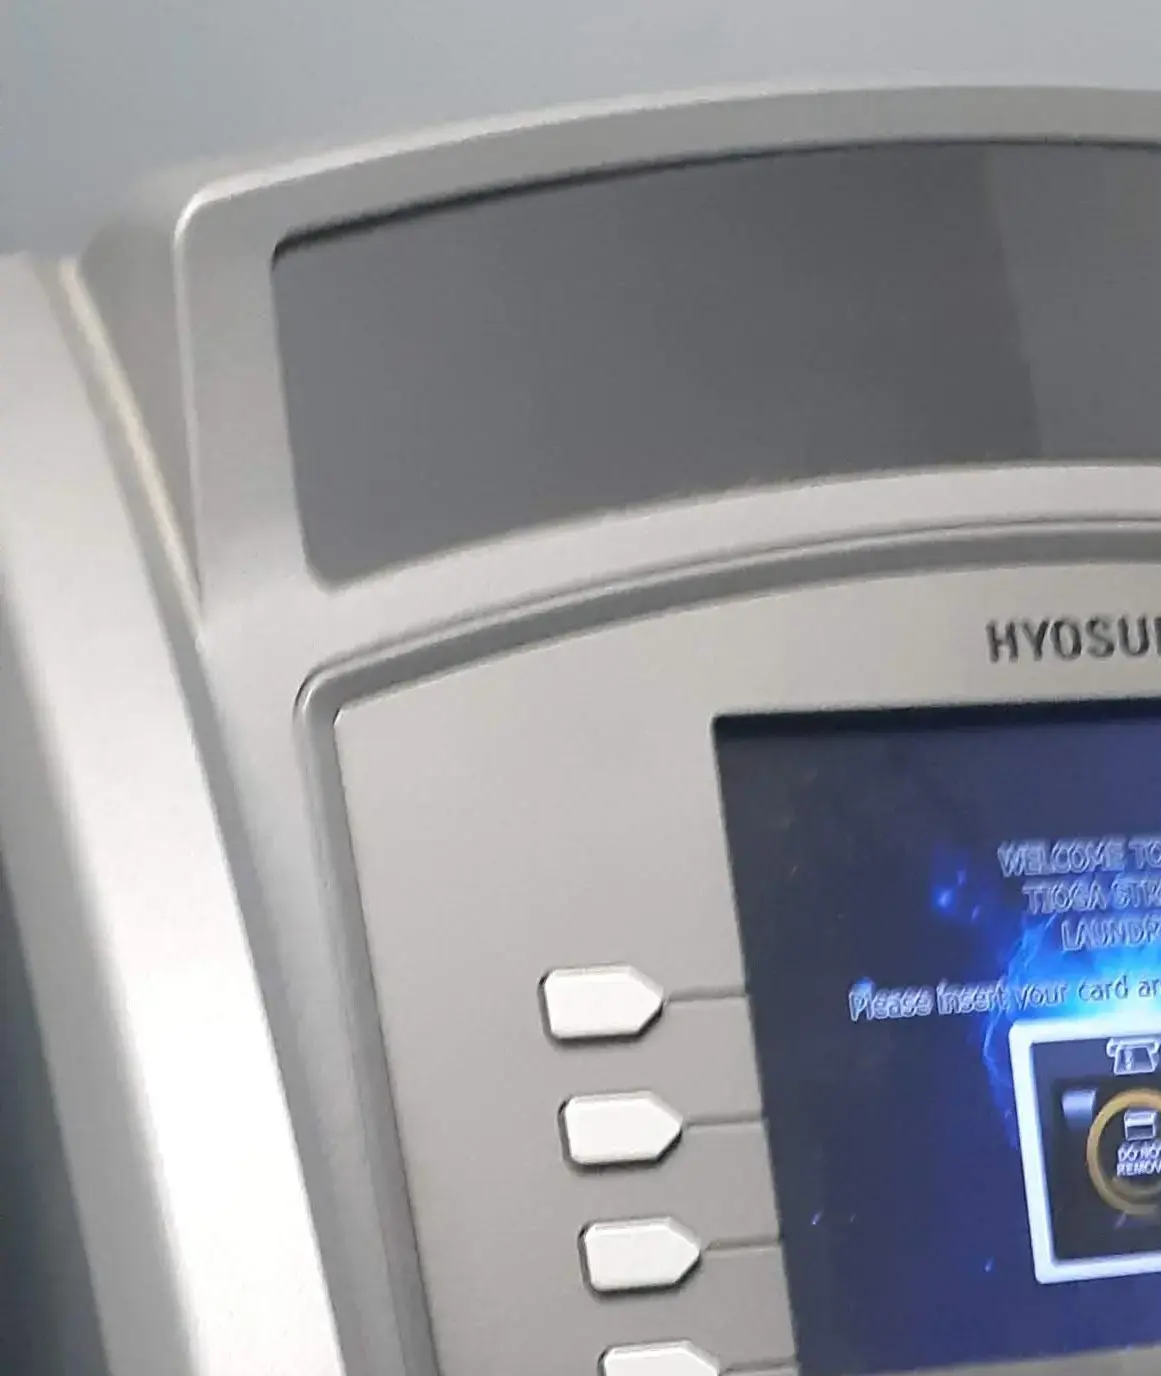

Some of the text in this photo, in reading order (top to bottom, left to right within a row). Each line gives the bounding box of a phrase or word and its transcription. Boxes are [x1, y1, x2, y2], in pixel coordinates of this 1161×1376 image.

[997, 835, 1126, 877] WELCOME
[1022, 879, 1107, 915] TIOGA
[848, 980, 932, 1021] Please
[1007, 984, 1067, 1013] your
[1078, 976, 1128, 1004] card
[1117, 1145, 1138, 1161] DO
